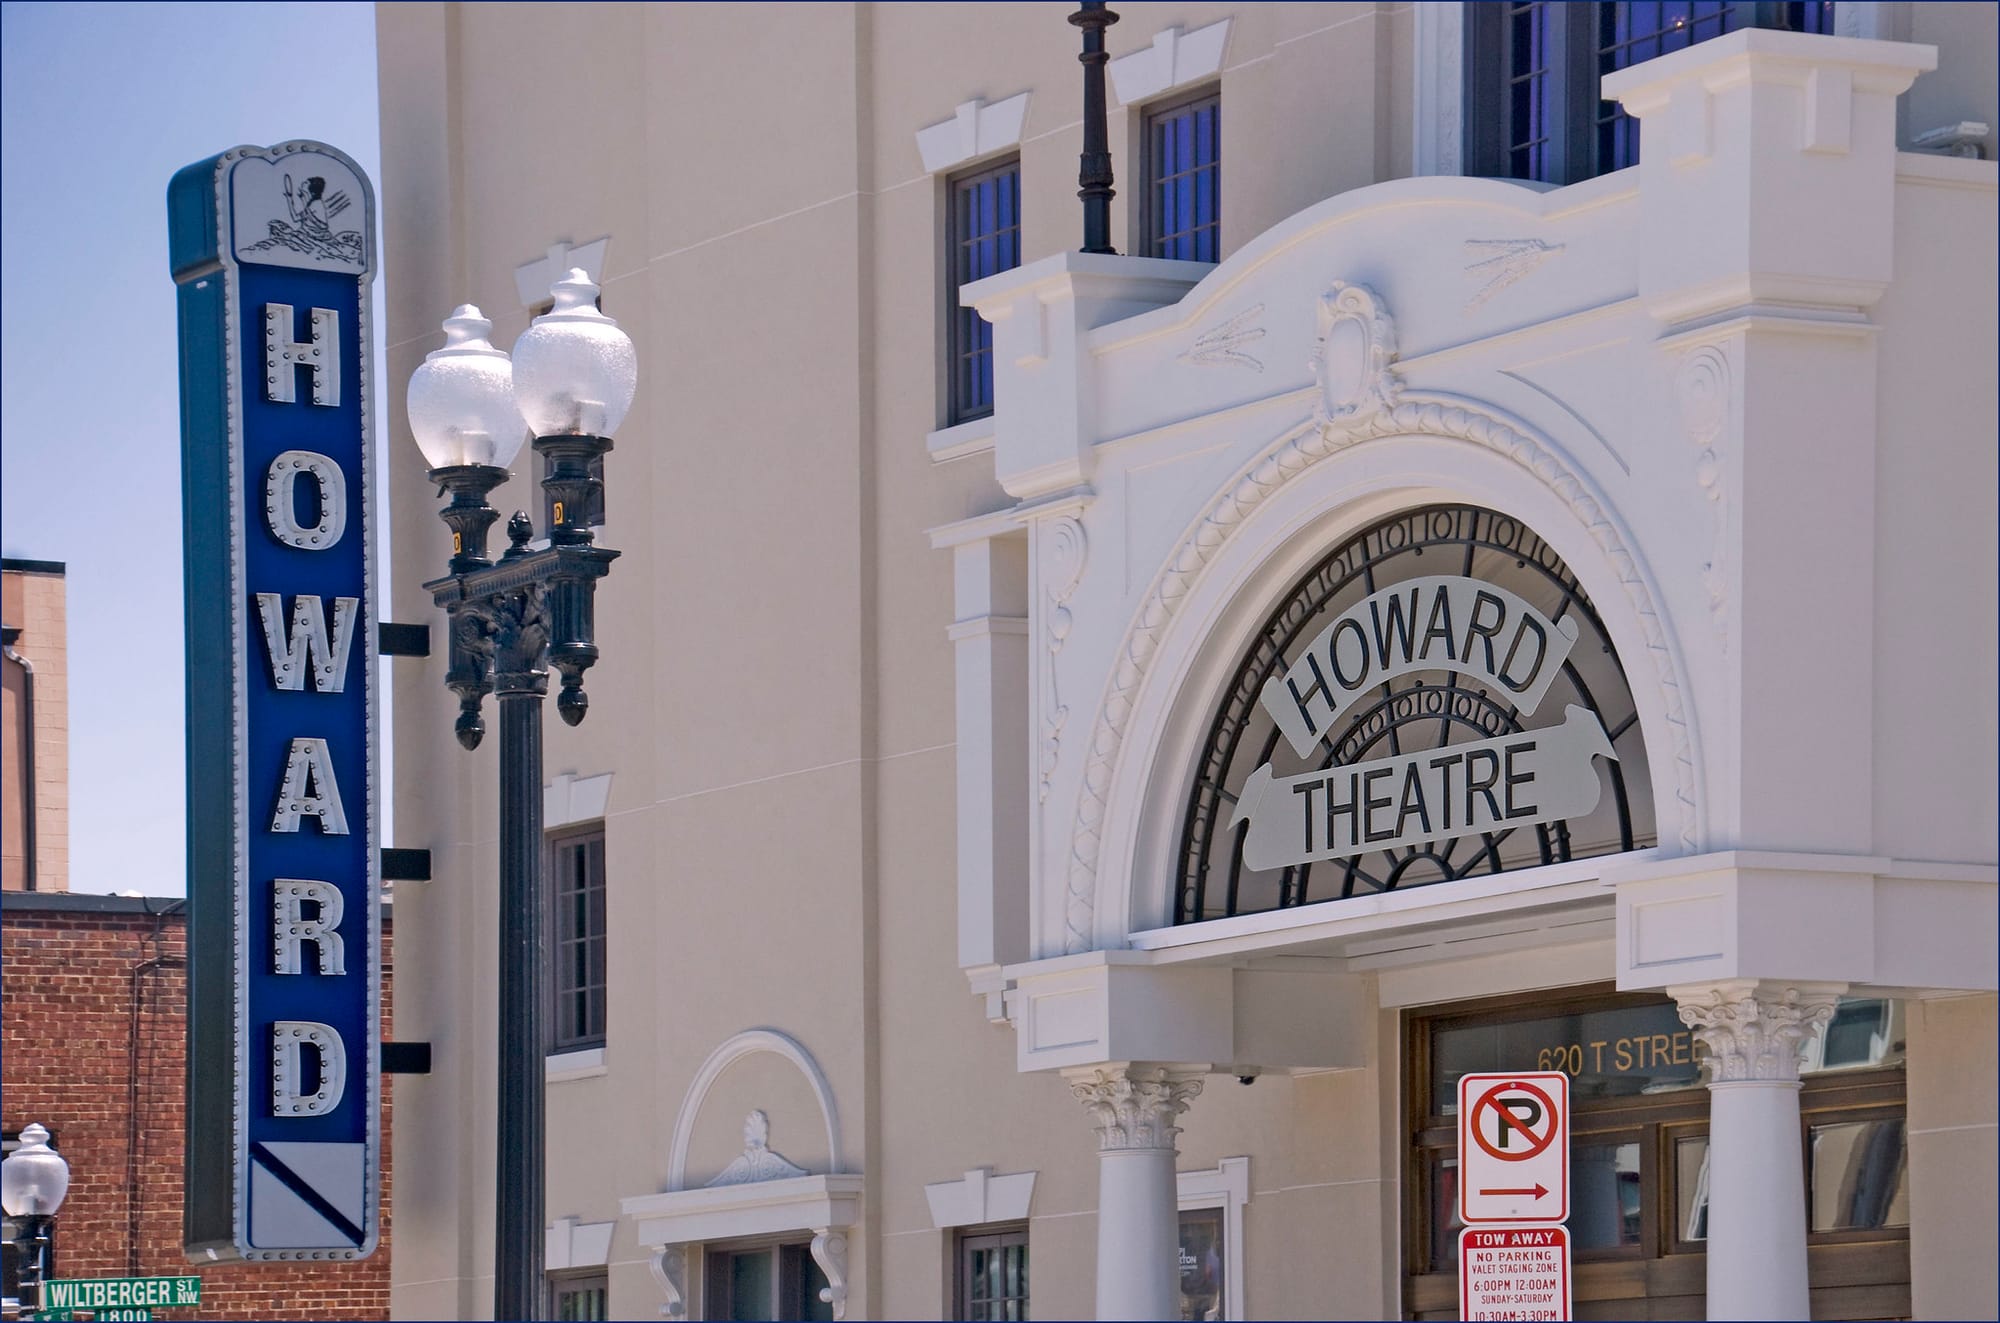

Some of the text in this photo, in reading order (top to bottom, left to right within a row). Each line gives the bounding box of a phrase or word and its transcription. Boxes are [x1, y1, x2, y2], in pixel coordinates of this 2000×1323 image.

[1287, 585, 1547, 737] HOWARD
[257, 302, 359, 1117] HOWARD
[1293, 741, 1538, 854] THEATRE
[1538, 1032, 1702, 1076] 620 T STREE
[1475, 1231, 1555, 1246] TOW AWAY
[1477, 1250, 1552, 1262] NO PARKING
[1472, 1263, 1557, 1274] VALET STAGING ZONE
[1474, 1279, 1557, 1292] 6:00PM 12:00AM
[51, 1279, 194, 1308] WILTBERGER ST
[177, 1291, 198, 1304] NW
[1481, 1293, 1553, 1304] SUNDAY-SATURDAY
[100, 1309, 147, 1322] 1800
